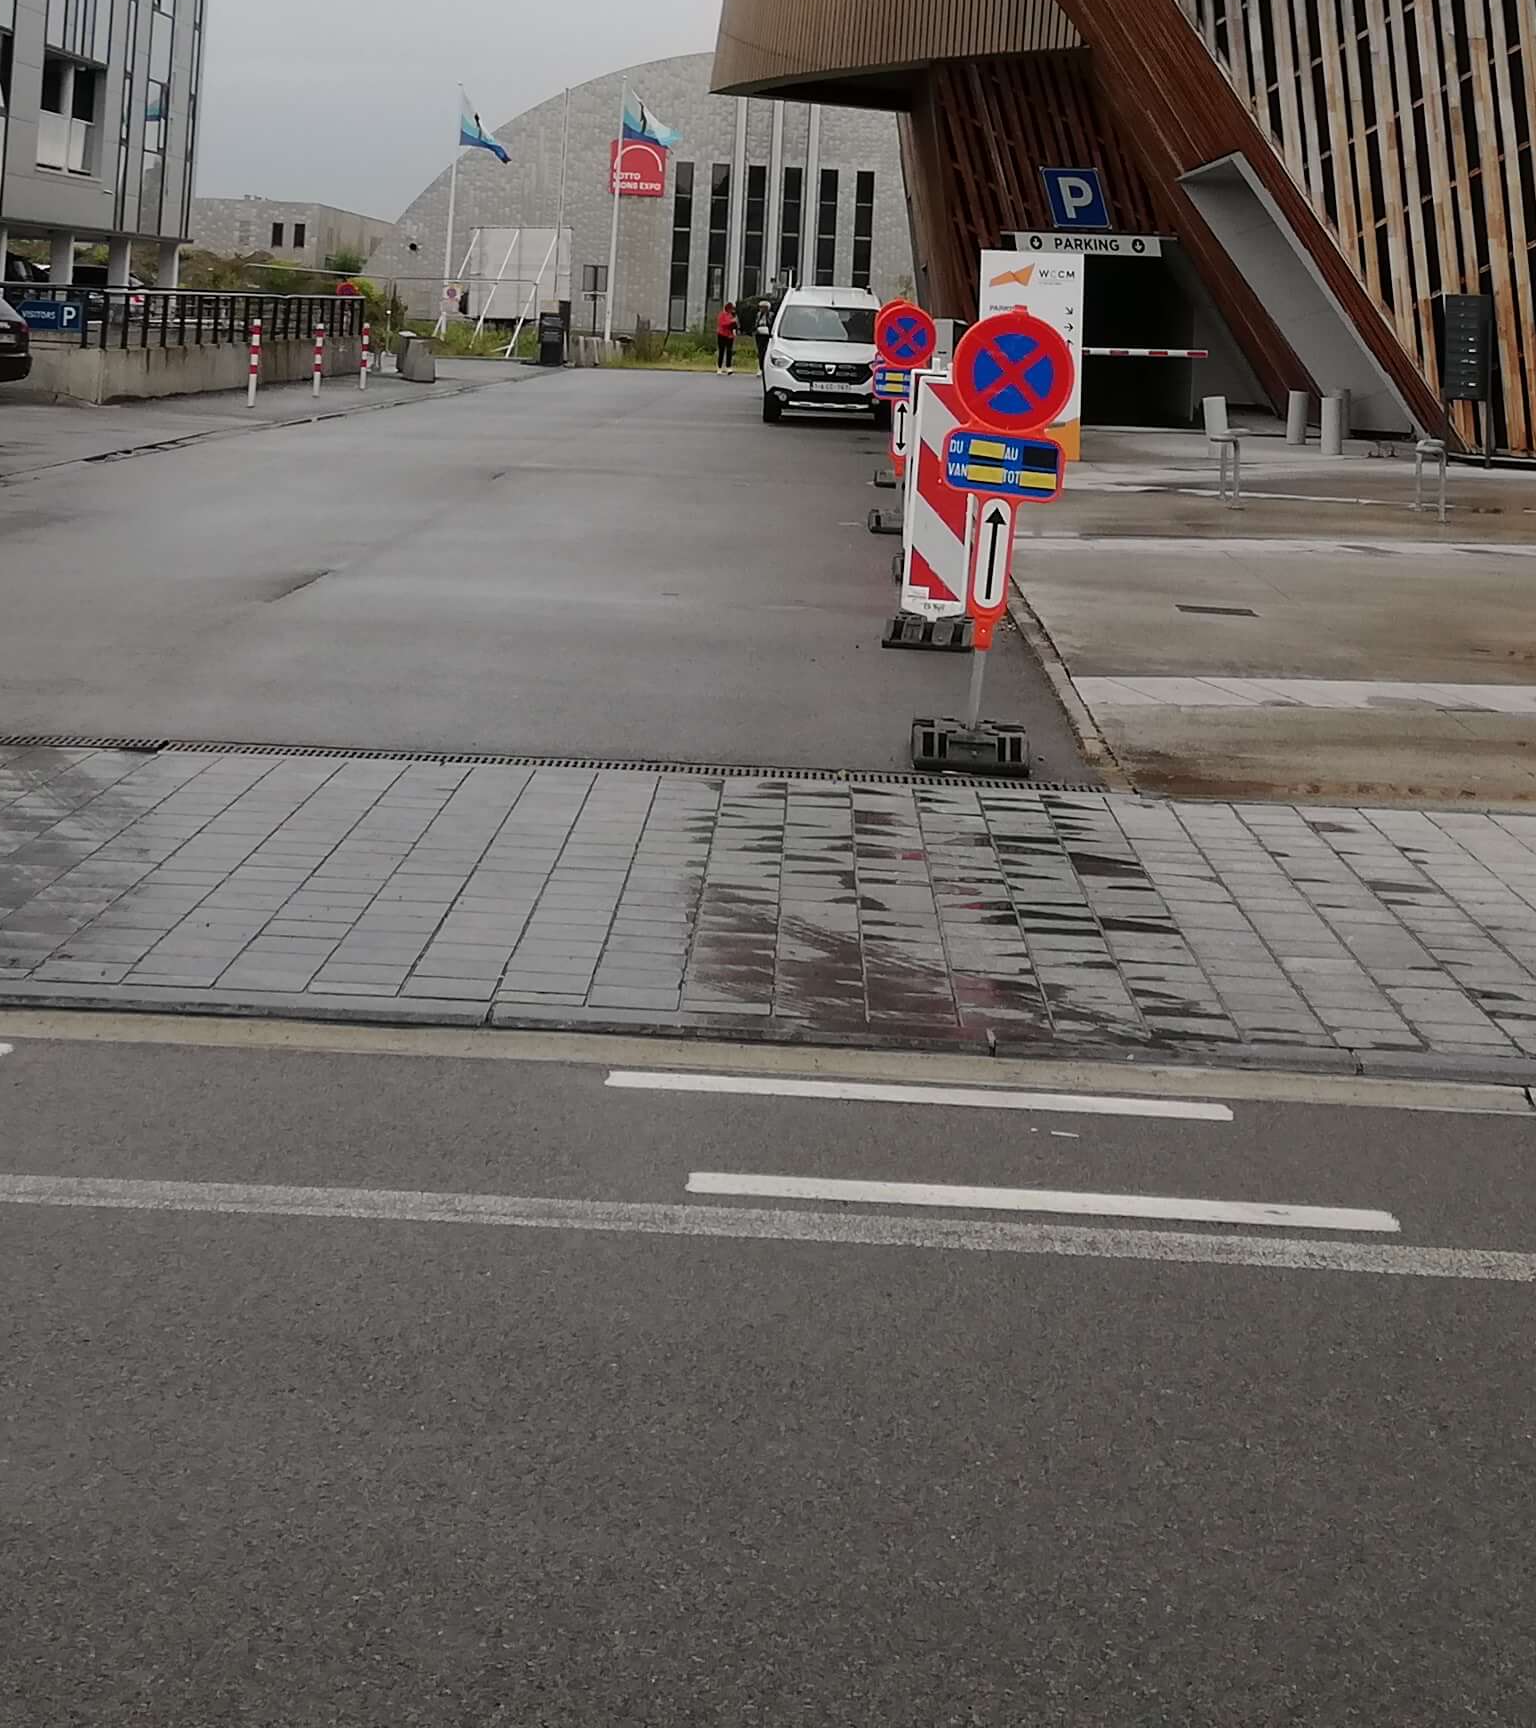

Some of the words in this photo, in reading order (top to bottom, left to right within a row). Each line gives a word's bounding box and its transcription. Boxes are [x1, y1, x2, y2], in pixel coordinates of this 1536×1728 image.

[1057, 176, 1093, 219] P
[1054, 237, 1120, 252] PARKING
[949, 439, 964, 454] DU
[1005, 447, 1019, 461] AU
